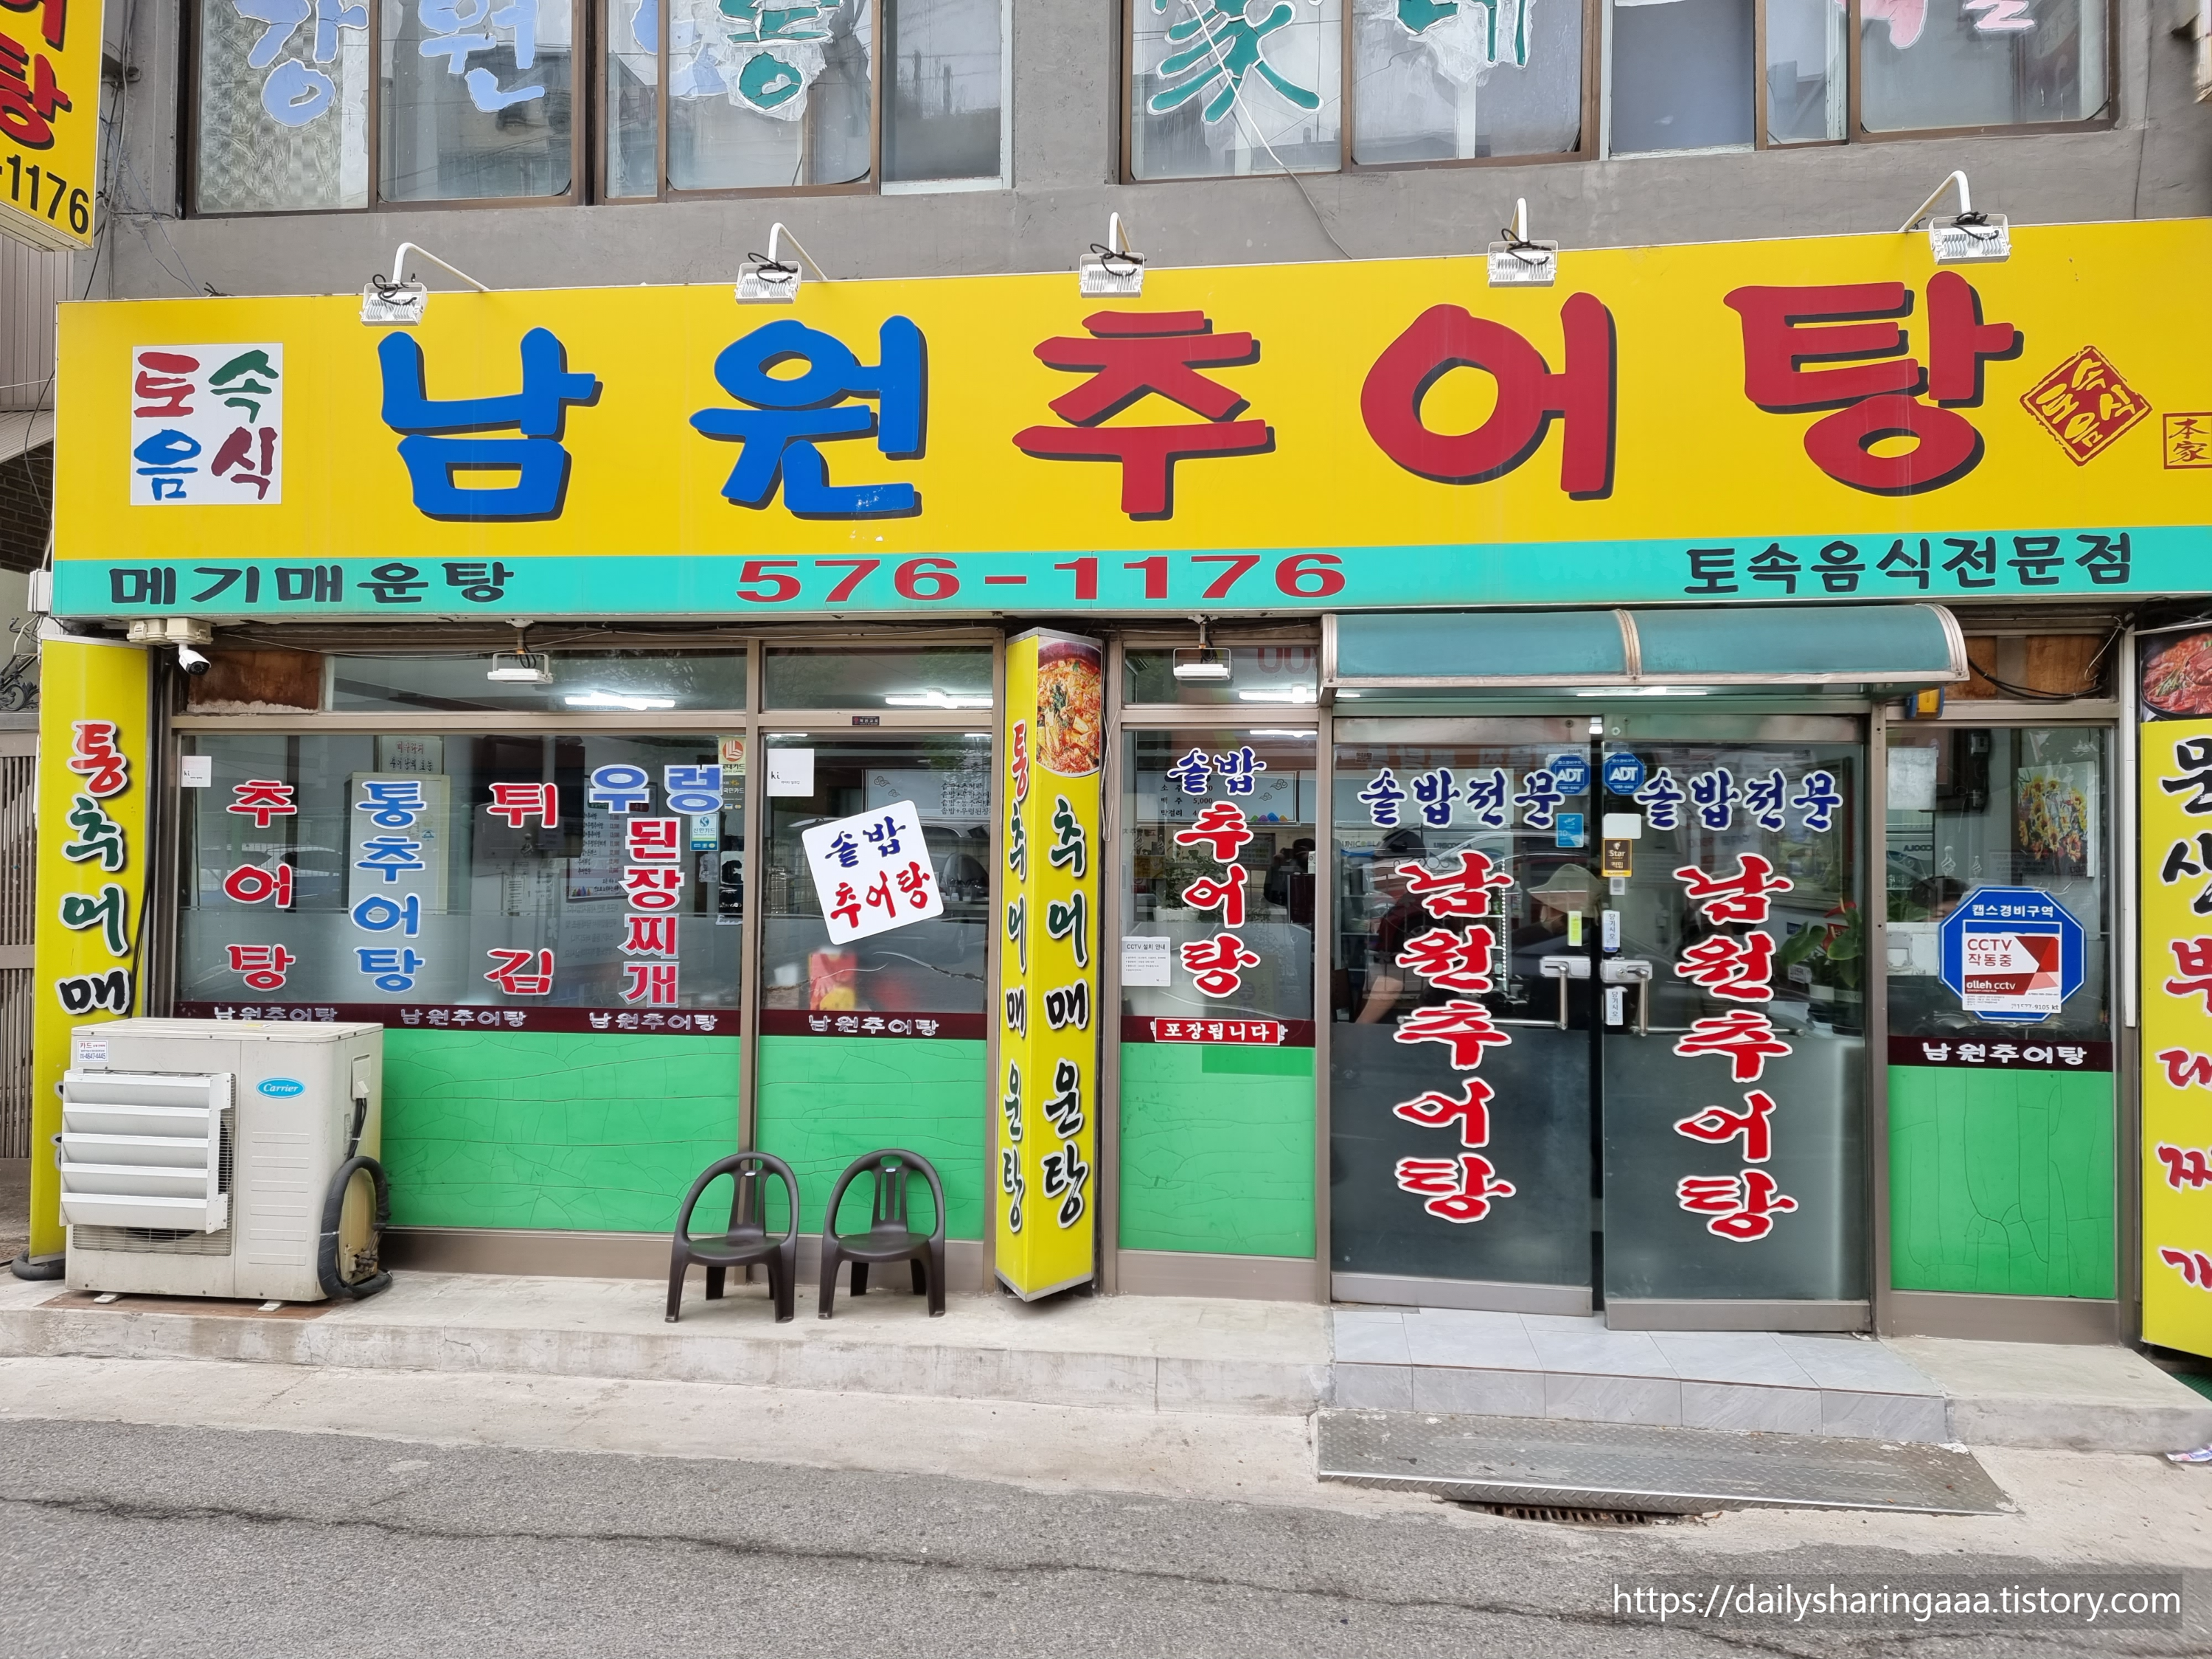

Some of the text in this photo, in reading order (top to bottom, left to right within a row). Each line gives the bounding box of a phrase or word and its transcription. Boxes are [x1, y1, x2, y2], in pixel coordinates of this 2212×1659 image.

[133, 349, 279, 423] 토속
[378, 270, 2024, 524] 남원추어탕
[133, 426, 278, 501] 음식
[2168, 418, 2211, 464] 本家
[109, 562, 514, 603] 메기매운탕
[736, 553, 1346, 603] 576-1176
[1685, 531, 2132, 595] 토속음식전문점
[590, 764, 724, 815] 우렁
[1556, 768, 1585, 782] ADT
[1609, 767, 1638, 781] ADT
[1193, 797, 1213, 805] 5,000
[223, 779, 298, 992] 추어탕
[350, 780, 427, 993] 통추어탕
[484, 782, 559, 996] 튀김
[830, 861, 931, 928] 추어탕
[1173, 800, 1261, 998] 추어탕
[617, 816, 686, 1009] 된장찌개
[1972, 904, 2054, 918] 캡스경비구역
[1967, 939, 2012, 951] CCTV
[1968, 953, 2012, 967] 작동중
[1966, 980, 2016, 990] olleh cctv
[400, 1009, 526, 1028] 남원추어탕
[589, 1012, 718, 1032] 남원추어탕
[808, 1015, 939, 1037] 남원추어탕
[1164, 1022, 1270, 1041] 포장됩니다
[1394, 849, 1516, 1224] 남원추어탕
[1672, 852, 1800, 1243] 남원추어탕
[1922, 1043, 2088, 1066] 남원추어탕
[263, 1083, 299, 1093] Carrier
